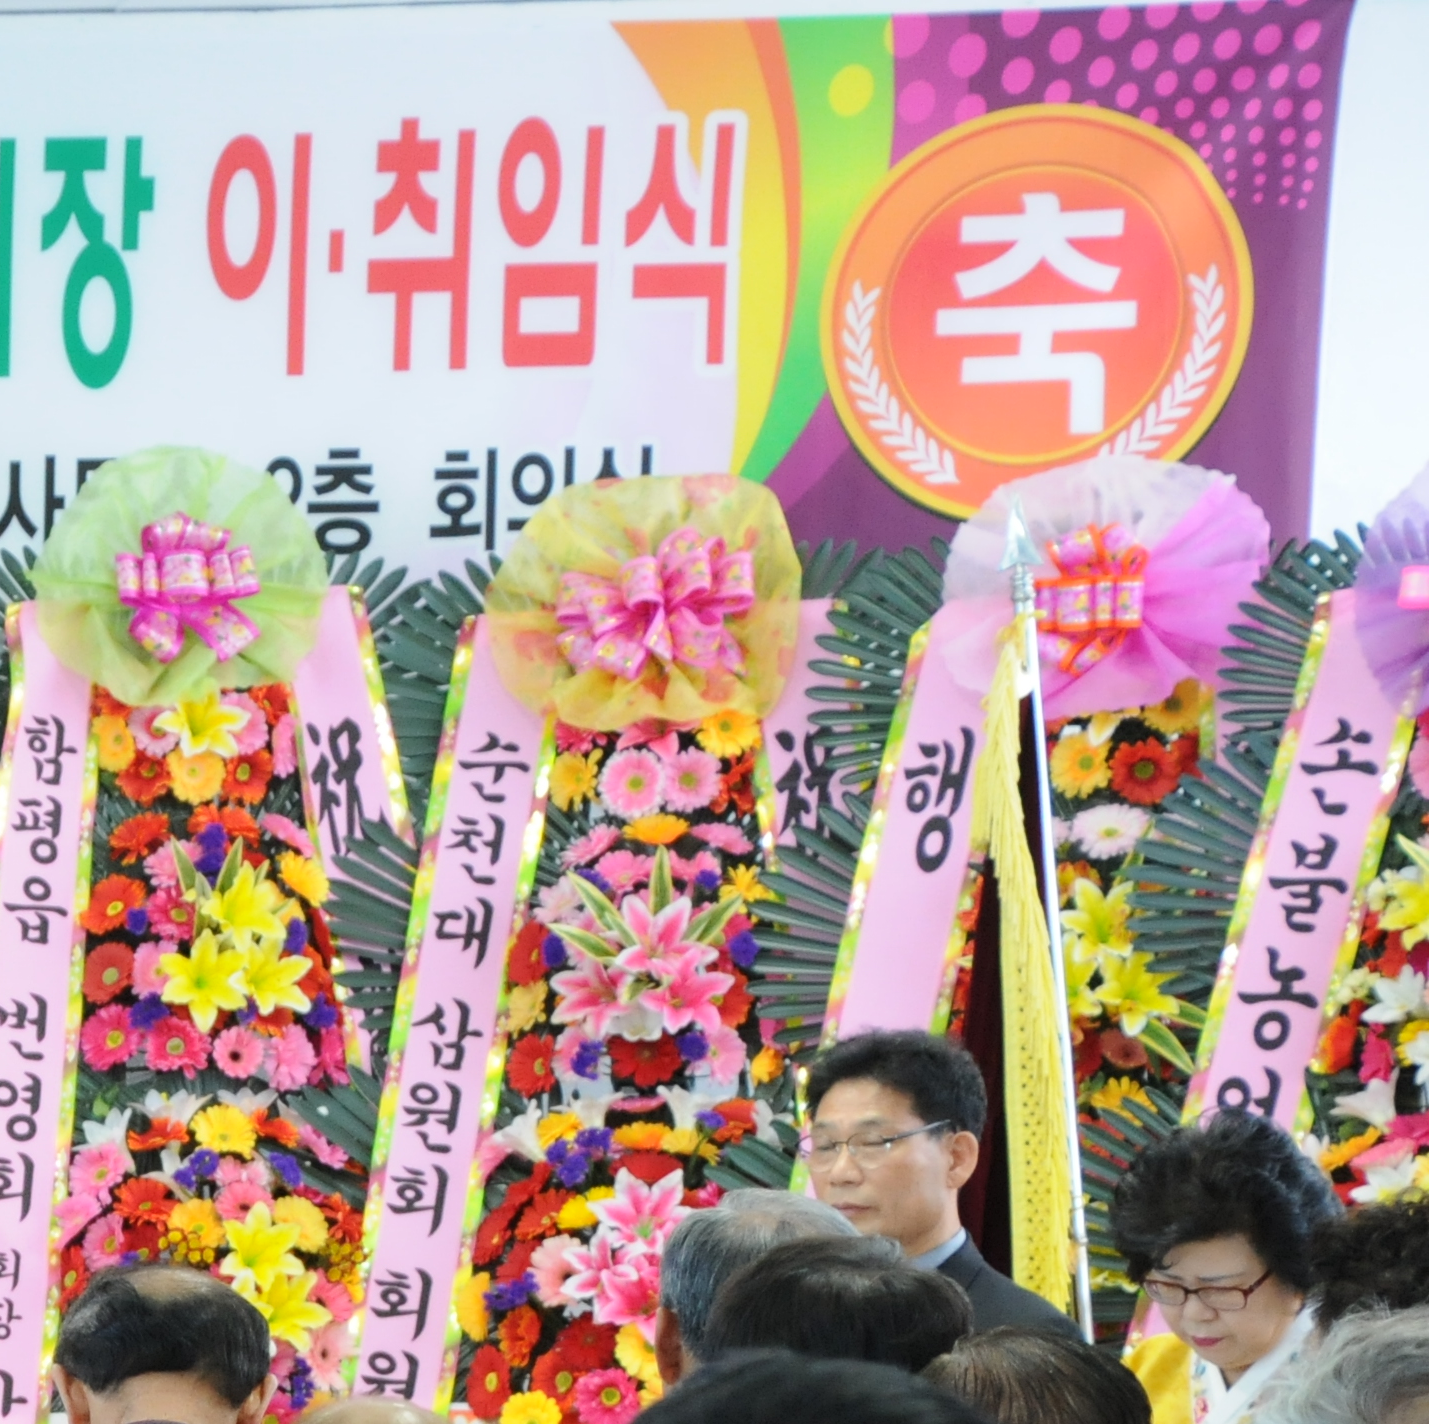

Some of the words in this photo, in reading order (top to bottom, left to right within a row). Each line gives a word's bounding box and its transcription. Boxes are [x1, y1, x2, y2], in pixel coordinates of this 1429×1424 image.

[932, 190, 1138, 437] 축
[3, 714, 79, 946] 함평읍
[305, 717, 366, 857] 祝
[903, 726, 976, 874] 행
